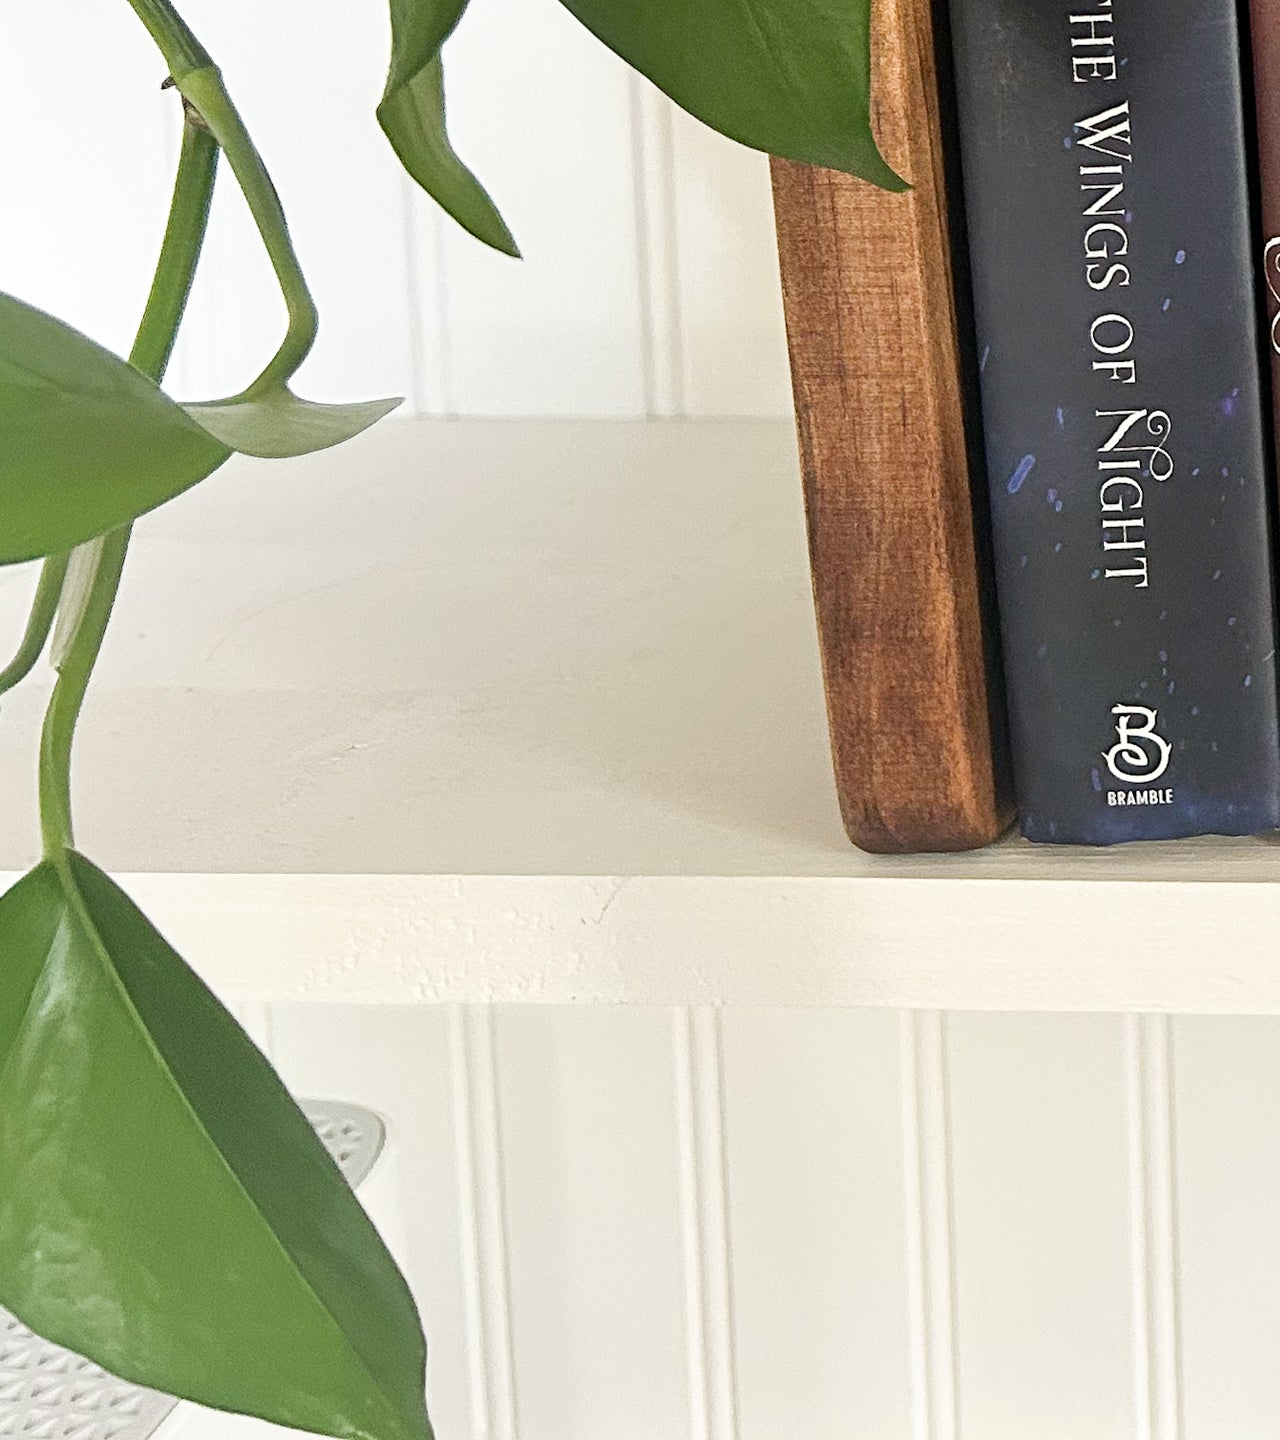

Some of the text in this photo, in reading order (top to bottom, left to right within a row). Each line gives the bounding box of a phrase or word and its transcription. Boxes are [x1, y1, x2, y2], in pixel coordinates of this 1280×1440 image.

[1072, 100, 1133, 292] WINGS
[1089, 312, 1139, 385] OF
[1094, 408, 1174, 590] NIGHT
[1107, 787, 1174, 807] BRAMBLE
